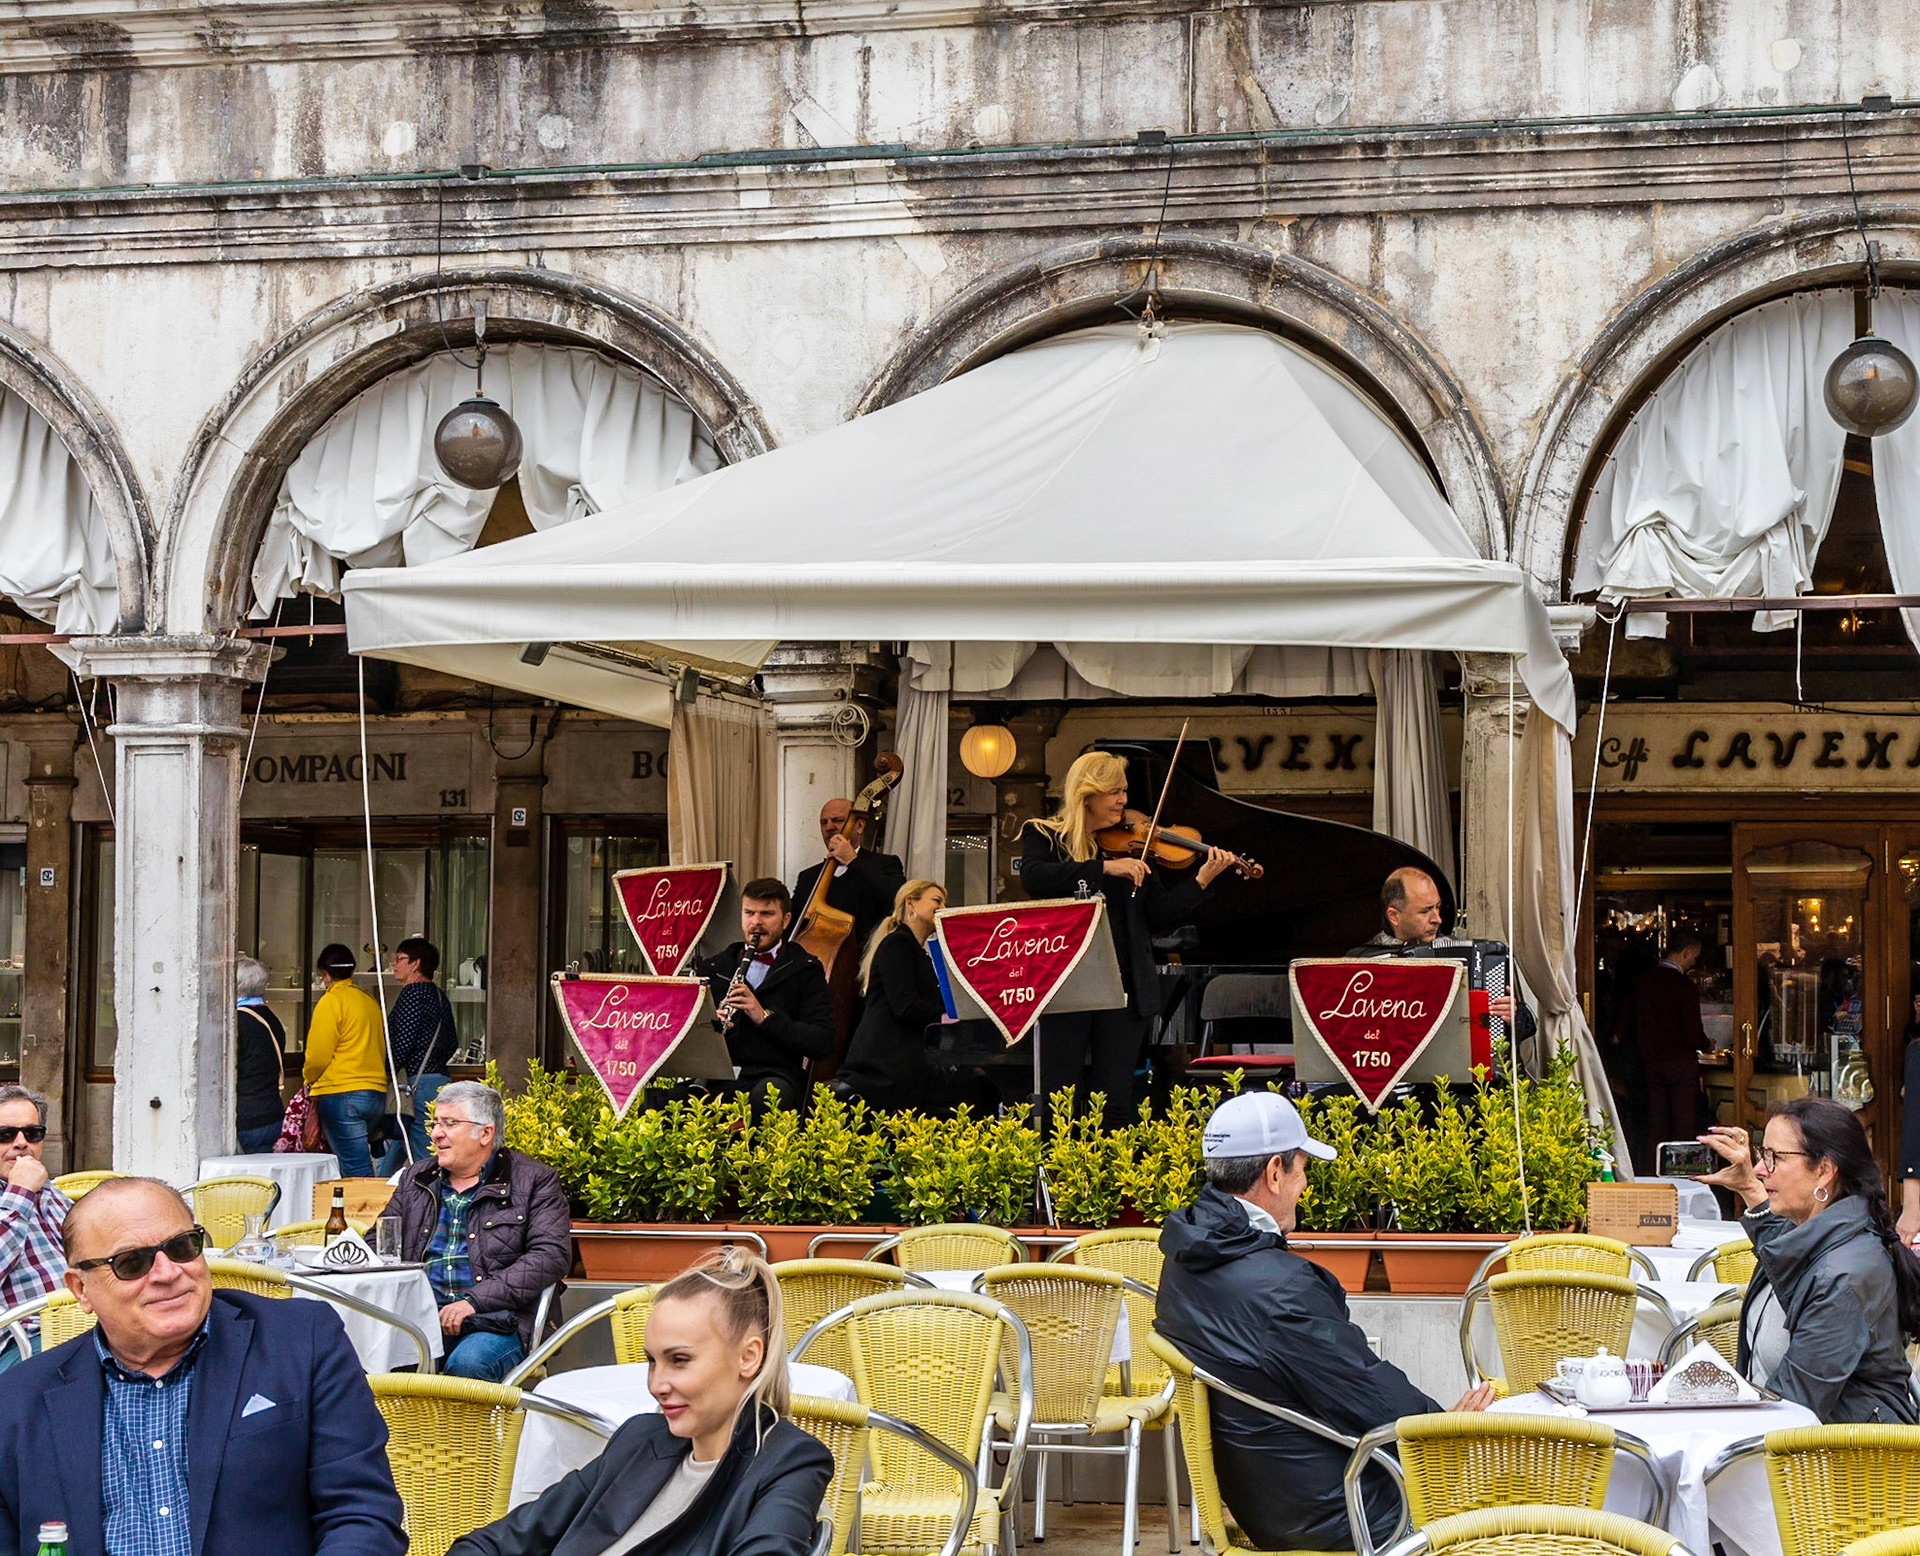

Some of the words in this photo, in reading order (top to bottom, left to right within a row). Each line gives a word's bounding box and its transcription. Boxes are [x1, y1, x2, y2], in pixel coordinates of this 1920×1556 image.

[439, 788, 467, 807] 131
[637, 878, 703, 922] Lavena
[655, 944, 679, 959] 1750
[967, 917, 1069, 967] Lavena
[999, 987, 1035, 1005] 1750
[1319, 970, 1427, 1020] Lavena
[578, 985, 672, 1030] Lavena
[605, 1060, 637, 1076] 1750
[1352, 1051, 1391, 1067] 1750
